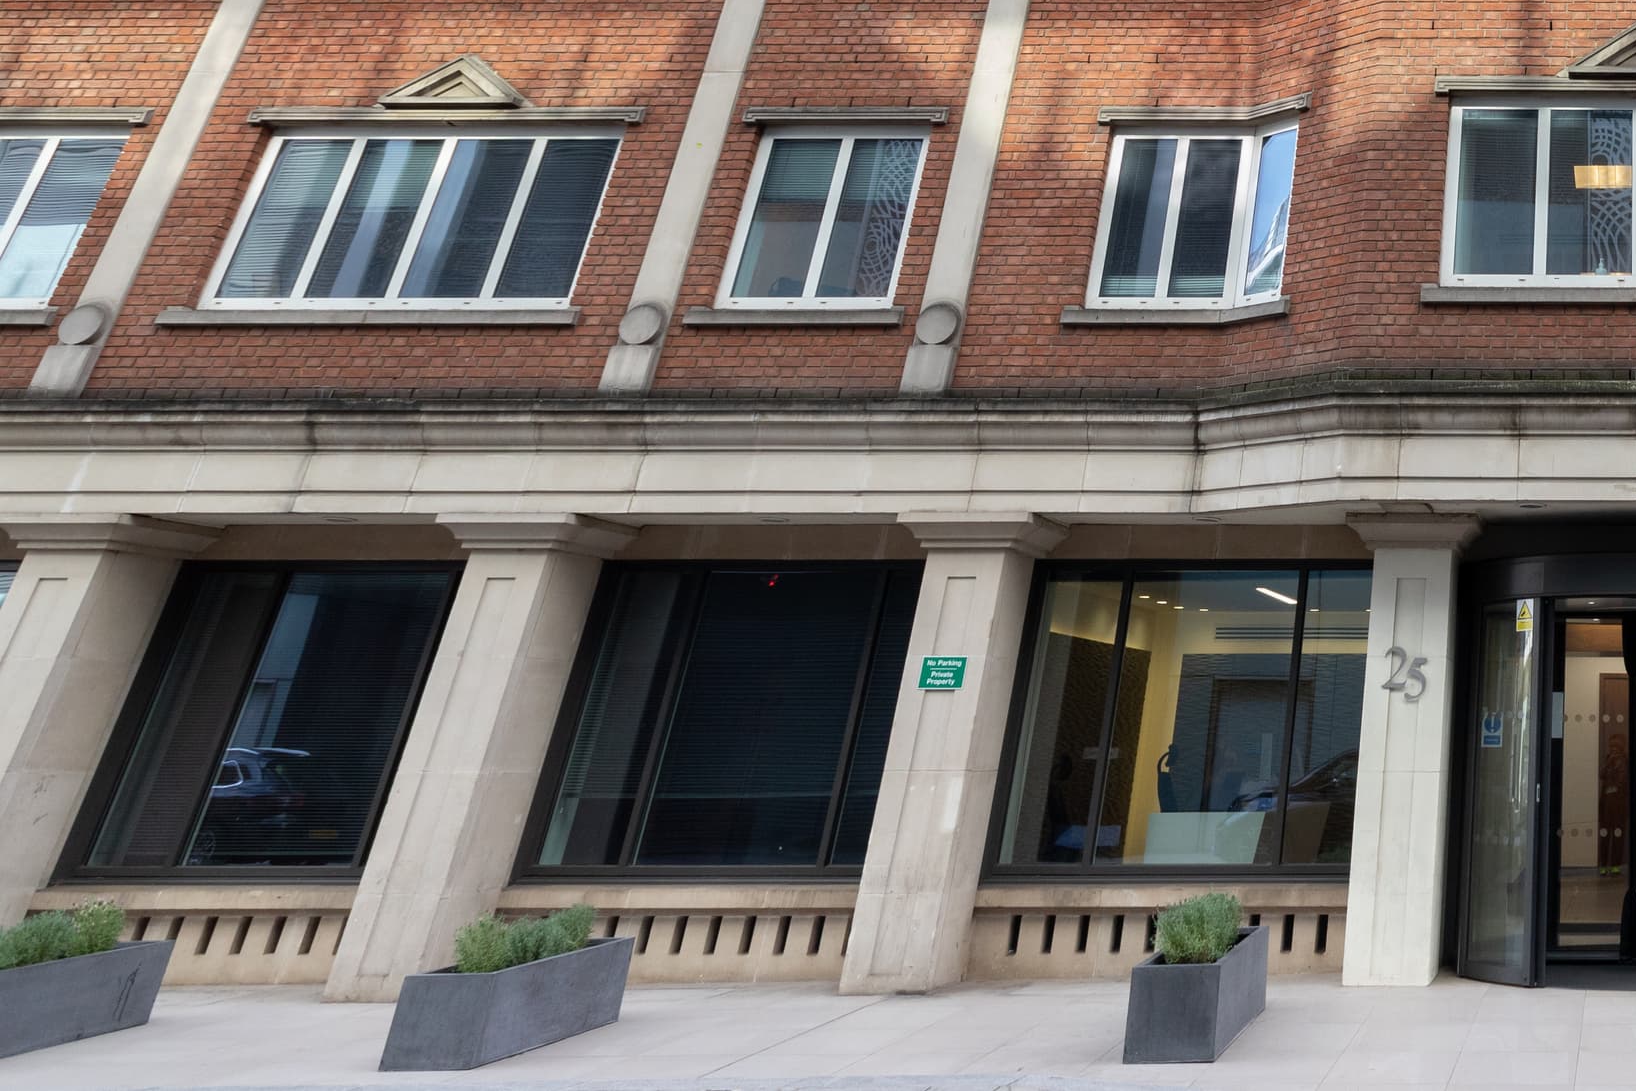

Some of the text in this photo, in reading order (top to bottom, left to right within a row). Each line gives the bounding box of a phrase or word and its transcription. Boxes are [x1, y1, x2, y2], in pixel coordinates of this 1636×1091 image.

[937, 660, 963, 668] Parking
[1381, 646, 1428, 703] 25
[926, 678, 956, 686] Property
